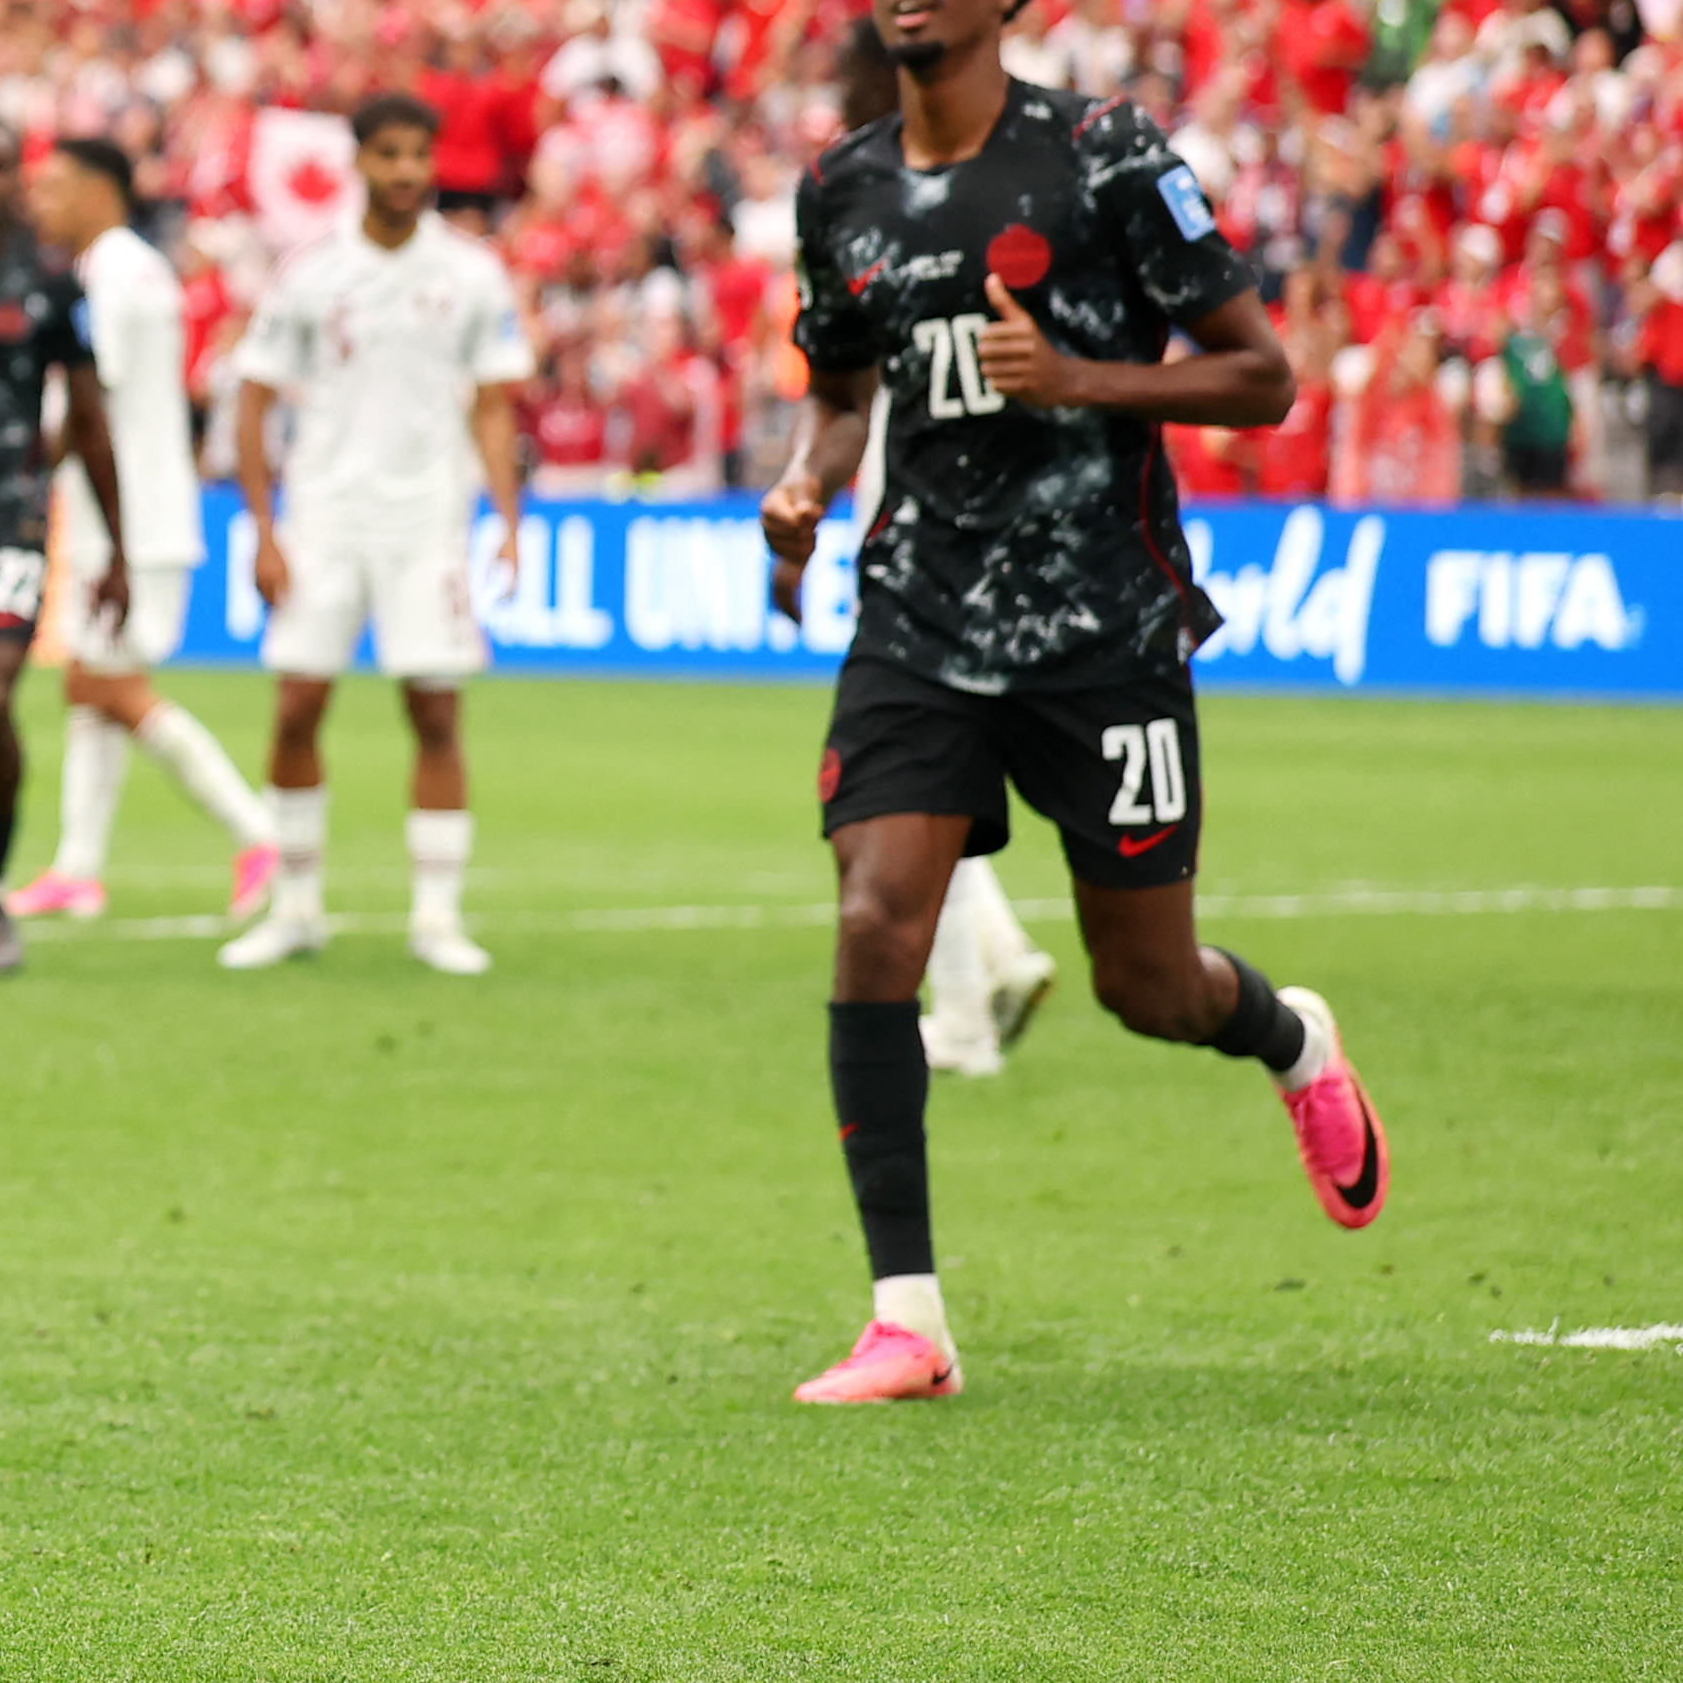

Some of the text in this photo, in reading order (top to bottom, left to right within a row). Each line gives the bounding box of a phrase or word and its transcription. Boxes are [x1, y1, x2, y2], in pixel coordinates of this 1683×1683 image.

[912, 313, 1006, 420] 20
[1425, 549, 1629, 651] FIFA
[1101, 717, 1187, 826] 20
